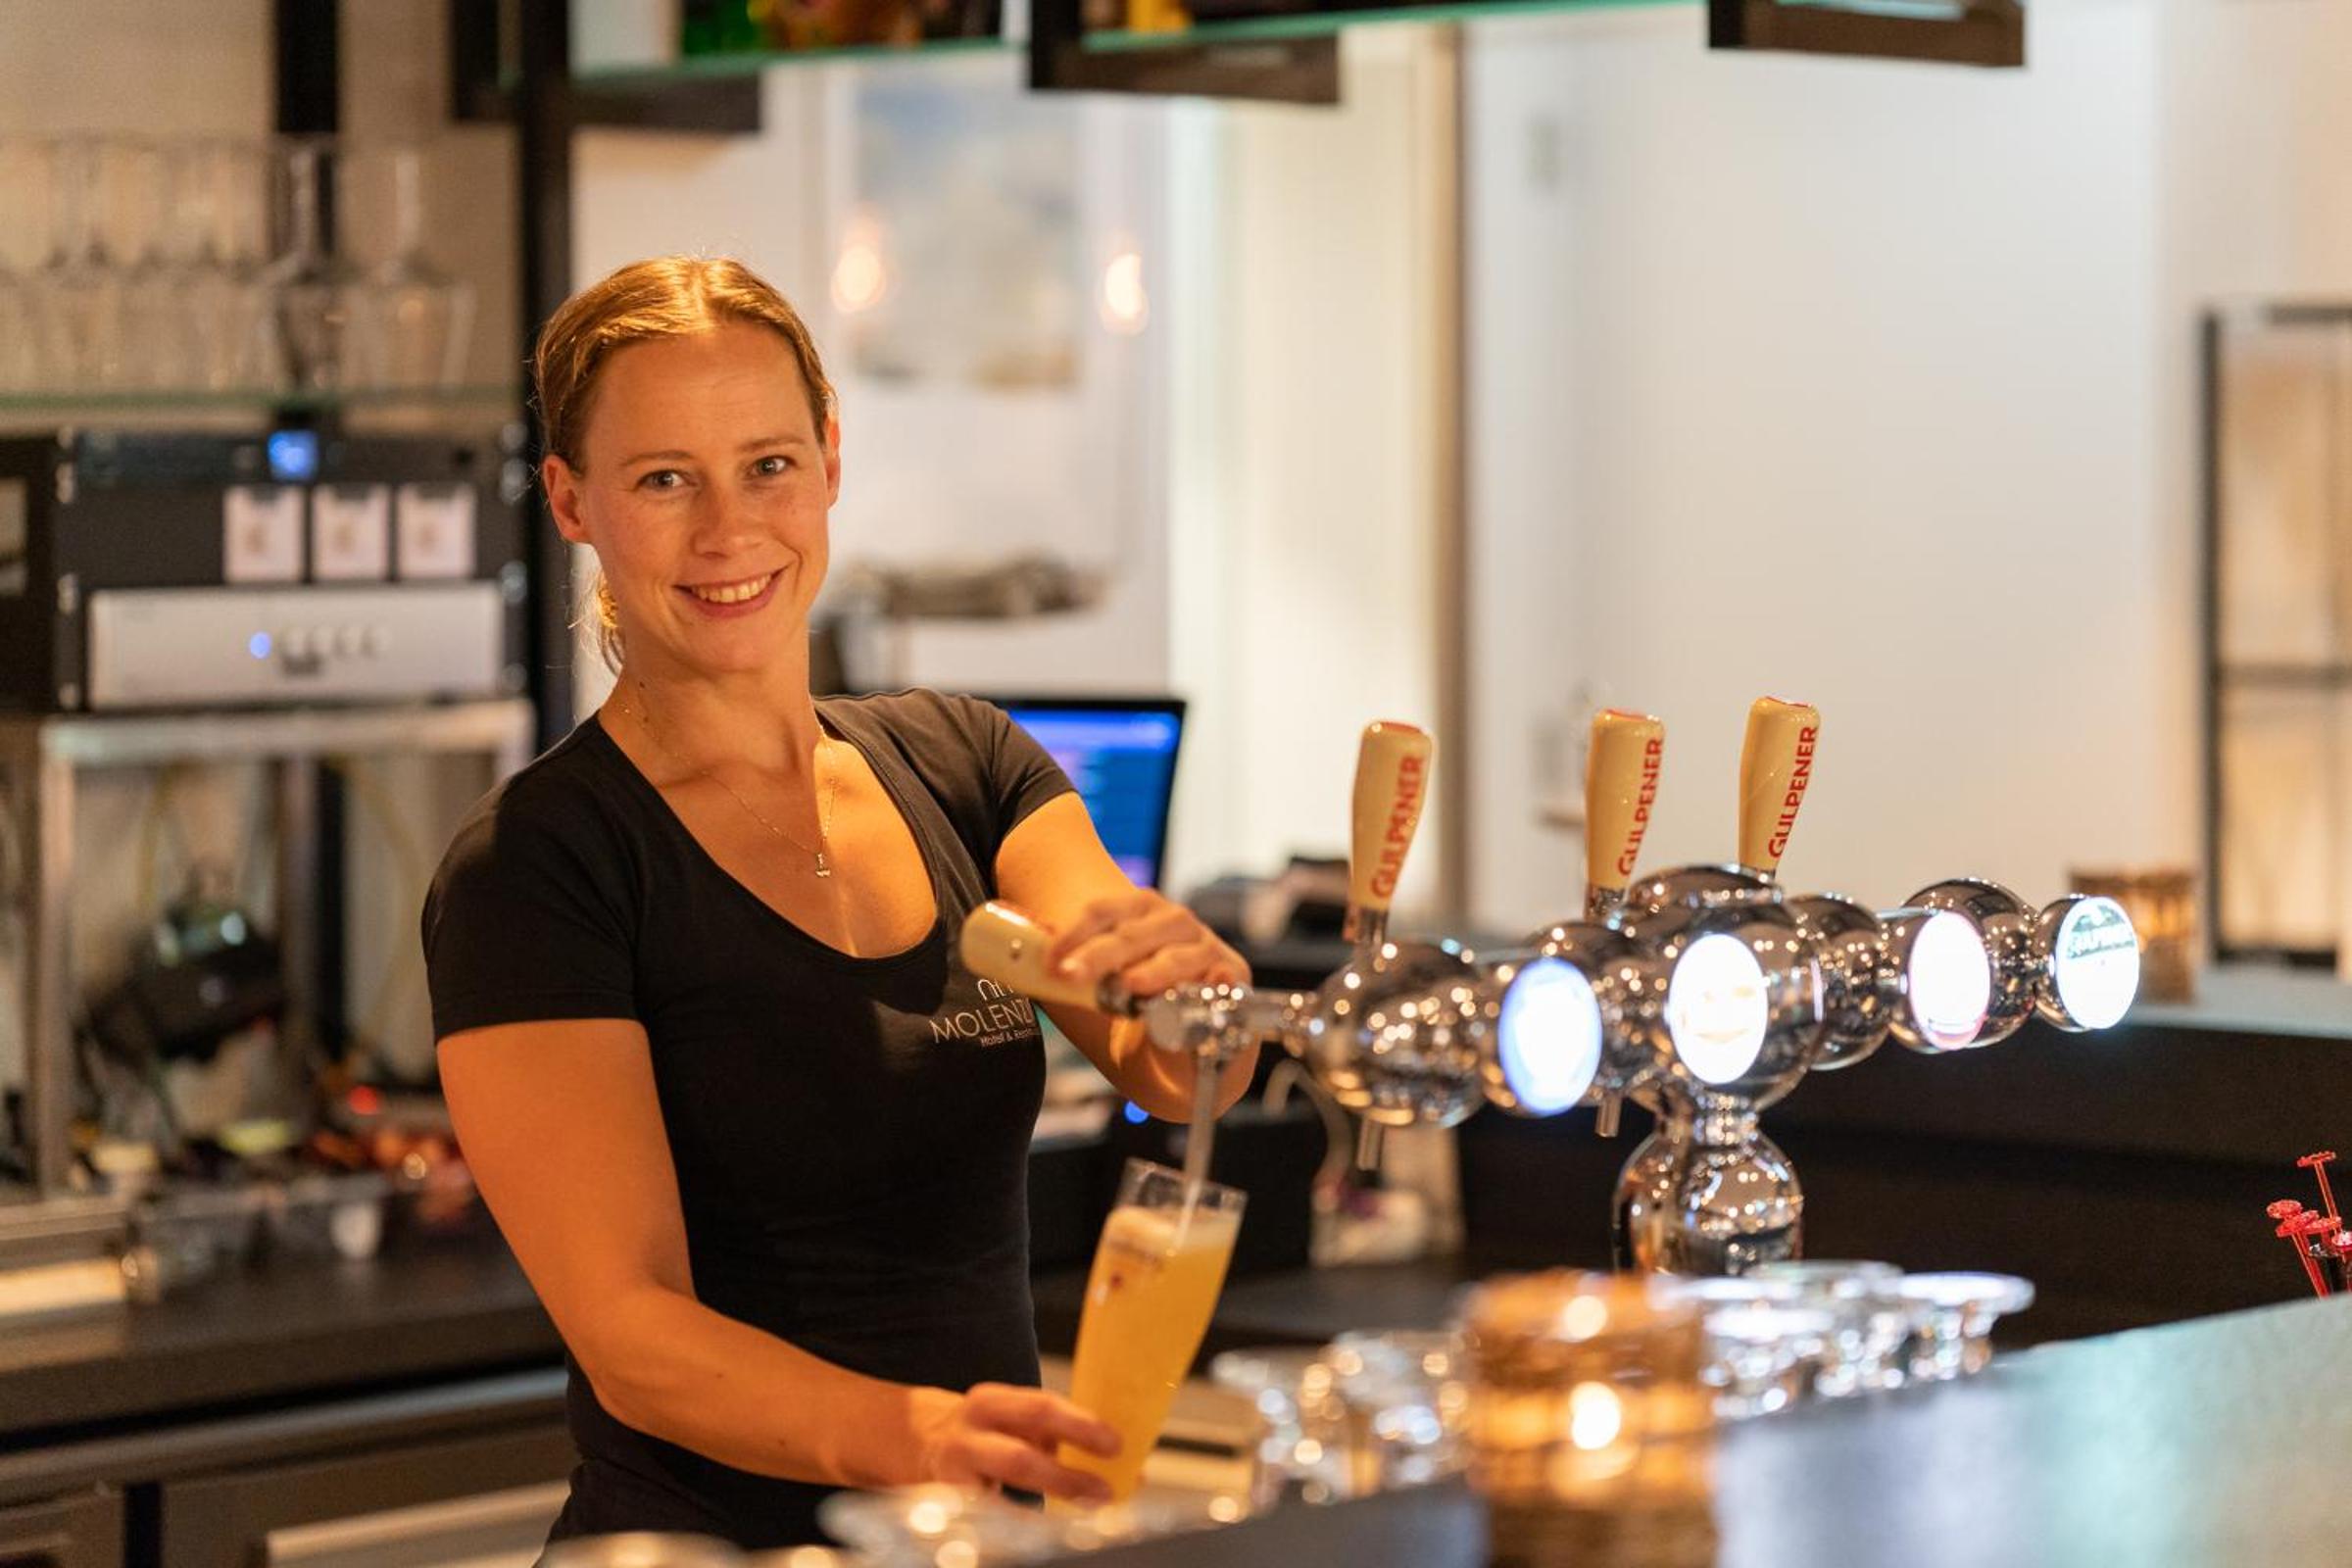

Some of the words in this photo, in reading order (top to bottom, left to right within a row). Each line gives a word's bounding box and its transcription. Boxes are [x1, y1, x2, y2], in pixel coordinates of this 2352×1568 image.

[1371, 756, 1426, 899] GULPENER
[1618, 739, 1662, 875] GULPENER
[1768, 726, 1818, 858] GULPENER
